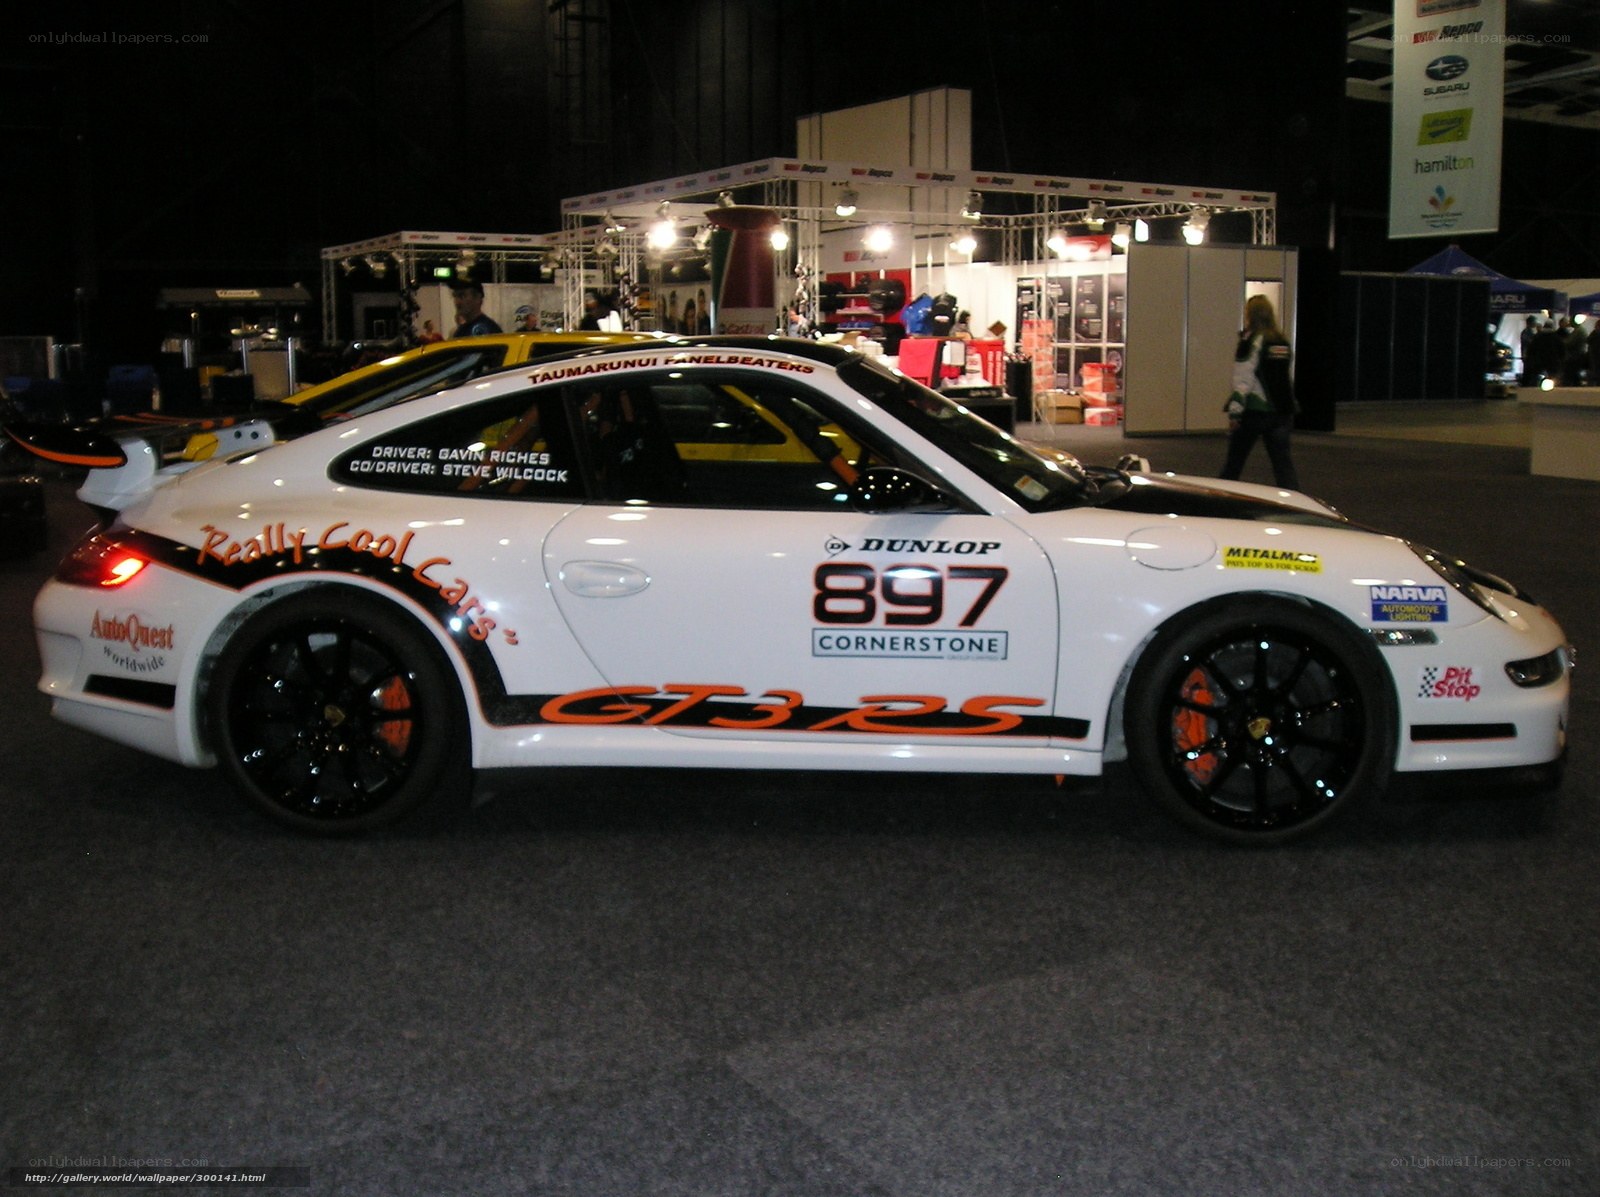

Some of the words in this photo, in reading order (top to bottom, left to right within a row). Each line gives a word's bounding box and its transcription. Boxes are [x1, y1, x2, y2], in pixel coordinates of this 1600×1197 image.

[1439, 21, 1483, 40] Repco
[1424, 82, 1470, 96] SUBARU
[1415, 155, 1474, 174] hamilton
[528, 360, 657, 384] TAUMARUNUI
[664, 356, 815, 375] PANELBEATERS
[371, 446, 432, 460] DRIVER:
[438, 448, 484, 461] GAVIN
[489, 451, 551, 466] RICHES
[349, 461, 435, 476] CO/DRIVER:
[442, 464, 490, 478] STEVE
[495, 466, 569, 483] WILCOCK
[319, 522, 415, 565] Cool
[859, 539, 1002, 555] DUNLOP
[813, 562, 1009, 627] 897
[1371, 586, 1446, 601] NARVA
[1382, 604, 1440, 613] AUTOMOTIVE
[1390, 613, 1431, 621] LIGHTING
[91, 609, 174, 652] AutoQuest
[819, 636, 998, 652] CORNERSTONE
[1444, 667, 1472, 686] Pit
[1432, 680, 1480, 702] Stop
[539, 683, 804, 728] GT3
[806, 693, 1046, 736] RS
